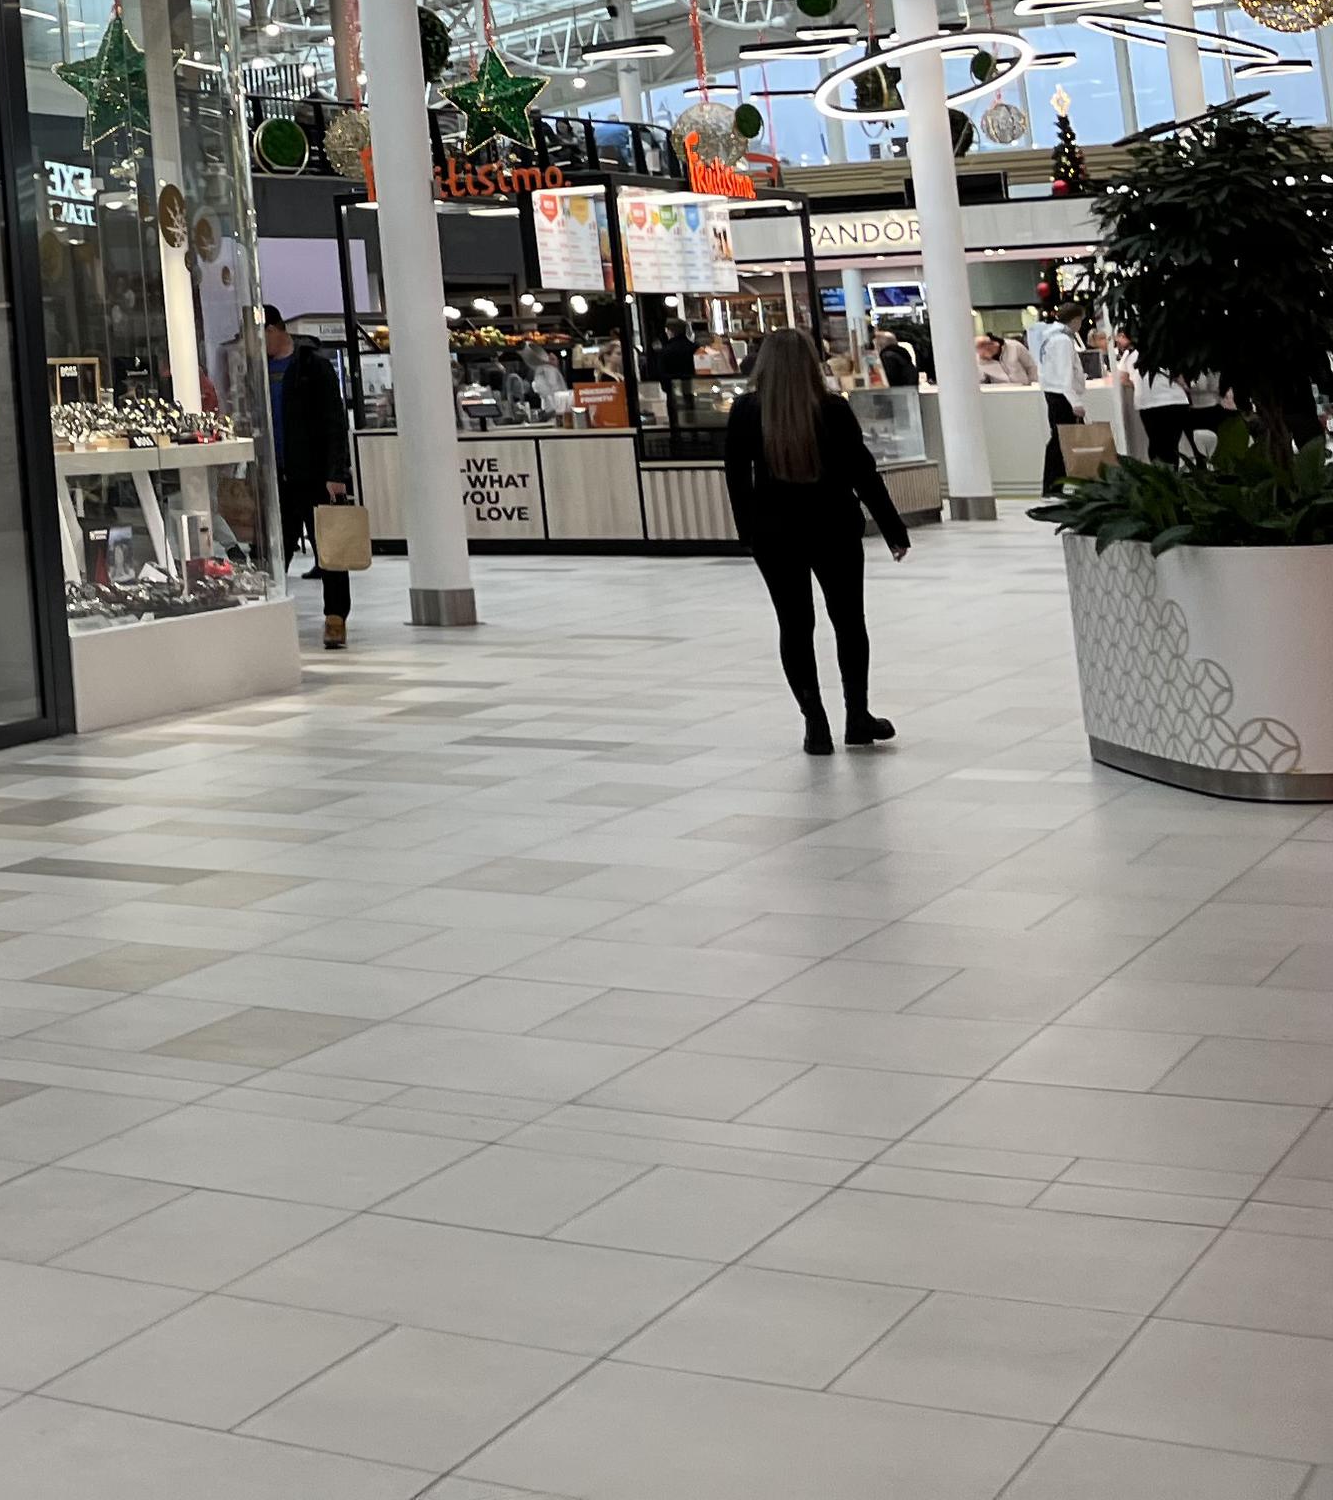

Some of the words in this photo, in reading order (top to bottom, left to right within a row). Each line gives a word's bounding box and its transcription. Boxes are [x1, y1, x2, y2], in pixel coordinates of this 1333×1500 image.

[460, 457, 499, 473] IVE
[466, 473, 530, 488] WHAT
[475, 506, 530, 521] LOVE
